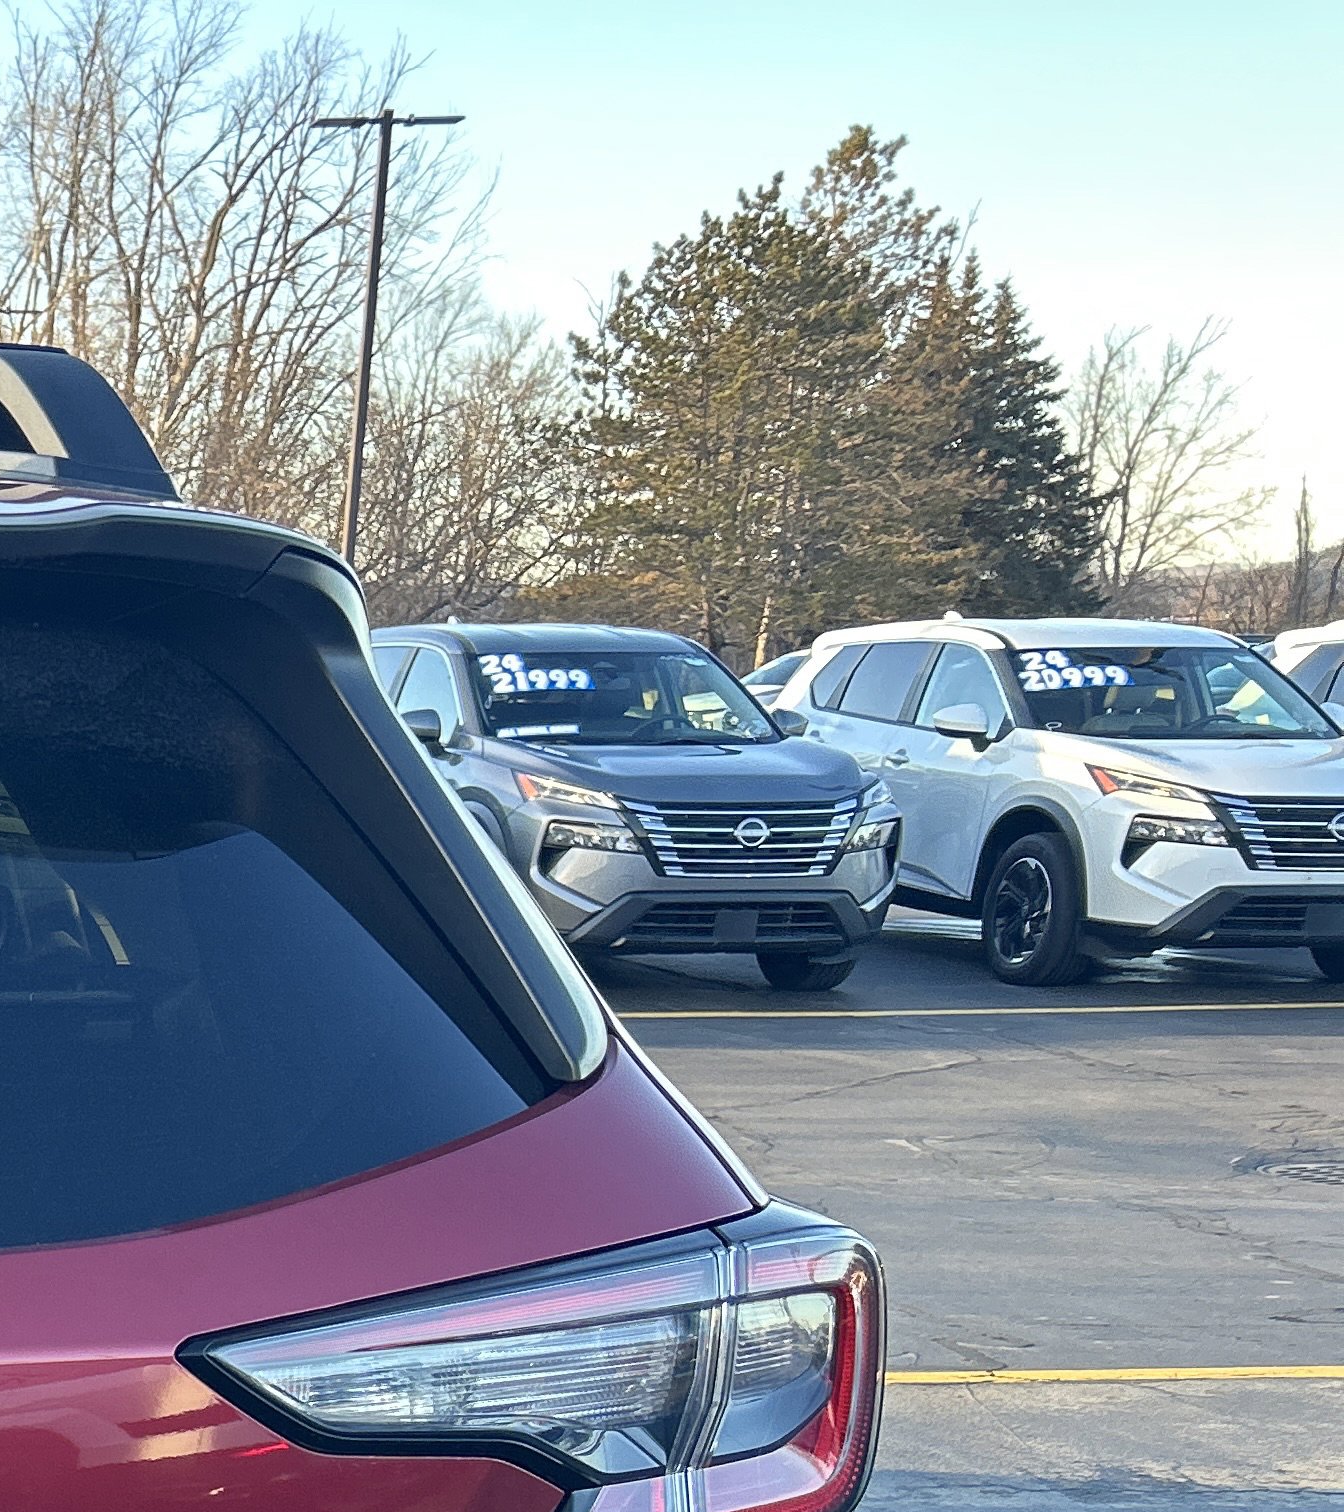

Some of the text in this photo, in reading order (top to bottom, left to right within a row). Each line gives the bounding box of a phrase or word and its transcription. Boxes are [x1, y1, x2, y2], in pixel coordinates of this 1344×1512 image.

[478, 654, 523, 675] 24
[1019, 650, 1069, 670] 24
[491, 669, 590, 693] 21999
[1017, 666, 1128, 691] 20999
